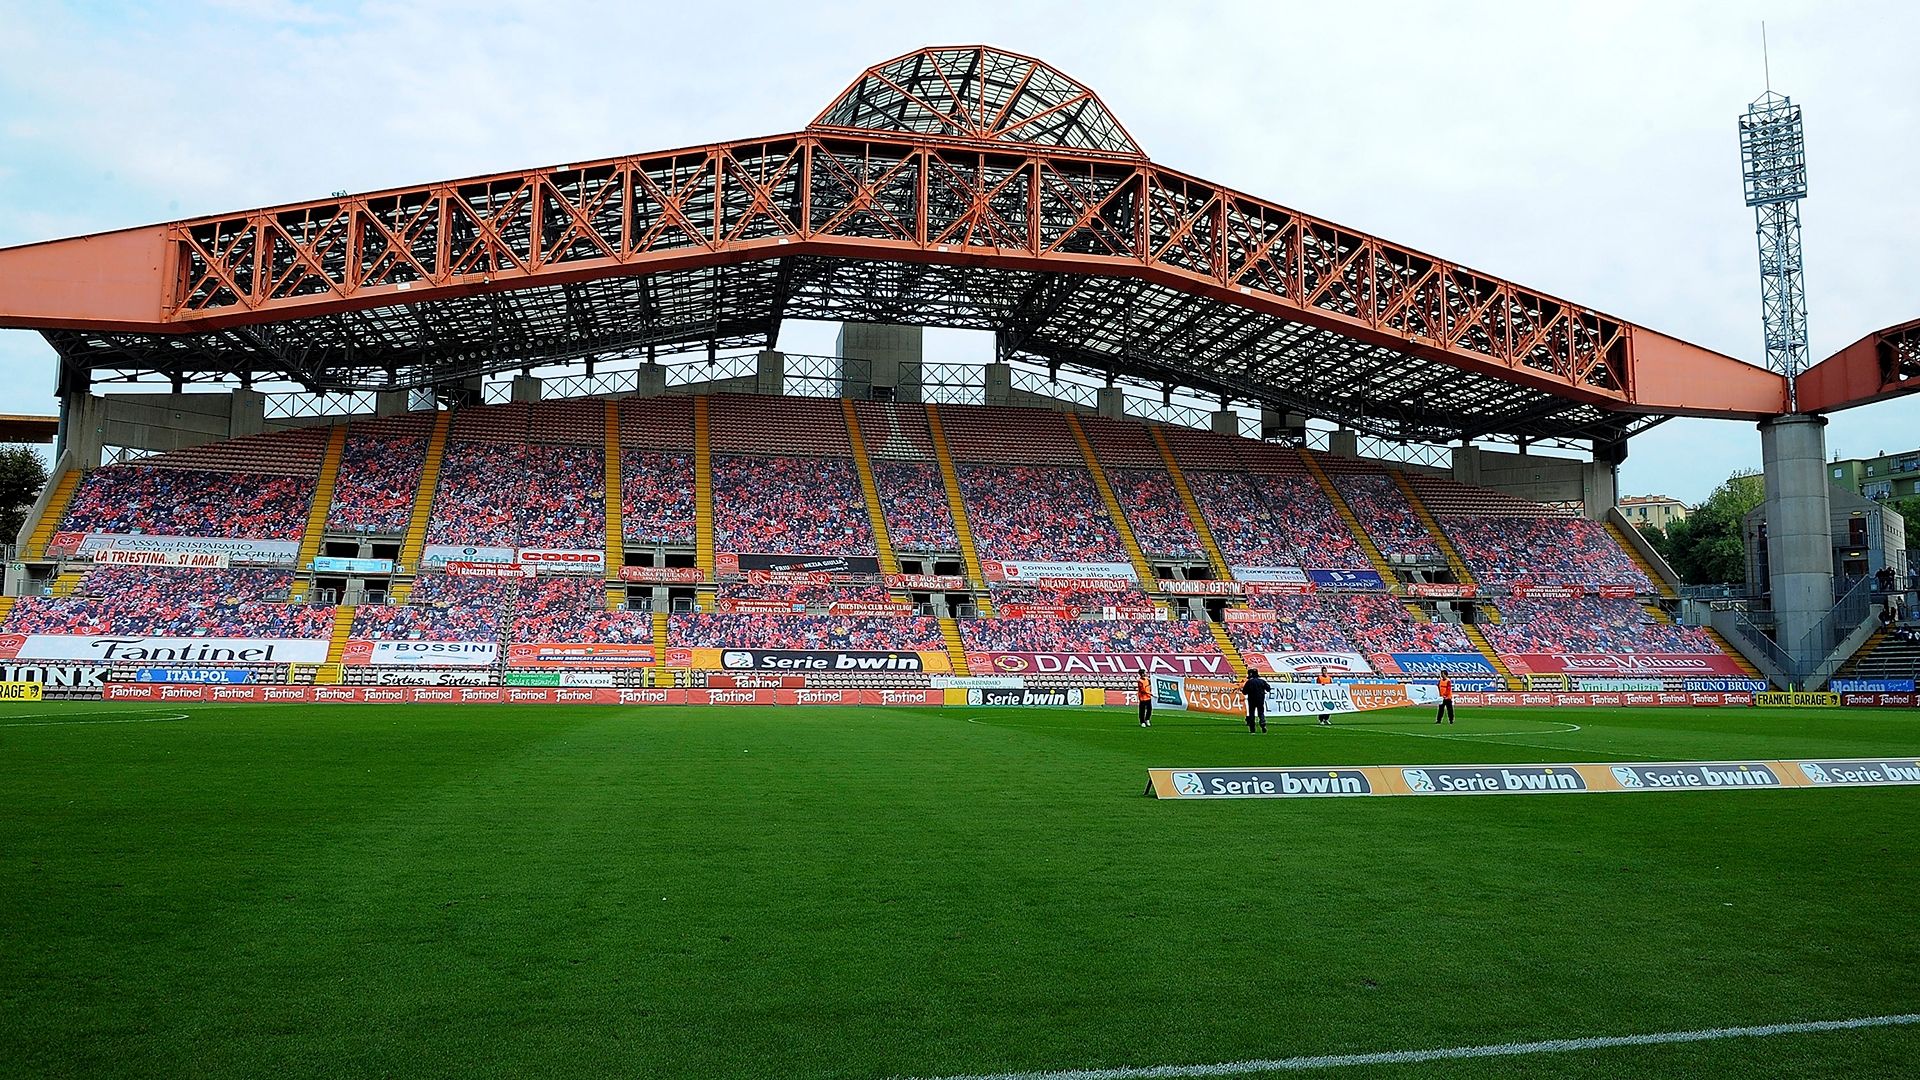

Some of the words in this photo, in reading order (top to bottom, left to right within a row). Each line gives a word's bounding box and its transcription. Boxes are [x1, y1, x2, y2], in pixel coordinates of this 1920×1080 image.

[176, 541, 253, 550] RISPARMIO
[94, 550, 108, 562] LA
[178, 554, 189, 565] SI
[191, 555, 220, 566] AMA!
[91, 638, 274, 662] Fantinel
[396, 643, 493, 653] BOSSINI
[760, 655, 828, 668] Serie
[834, 654, 919, 670] bwin
[1036, 654, 1178, 673] DAHLIA
[1175, 656, 1222, 672] TV
[1403, 662, 1489, 671] PALMANOVA
[1552, 654, 1606, 668] Testa
[1610, 654, 1707, 668] Molinaro
[166, 670, 229, 682] ITALPOL
[380, 674, 424, 686] Sixtus
[437, 674, 481, 686] Sixtus
[731, 675, 783, 688] Fantinel
[108, 685, 152, 699] Fantinel
[1186, 684, 1209, 692] MANDA
[1451, 684, 1484, 692] ERVICE
[1686, 680, 1726, 691] BRUNO
[1728, 681, 1766, 691] BRUNO
[158, 686, 202, 700] Fantinel
[206, 686, 254, 700] Fantinel
[261, 686, 304, 700] Fantinel
[312, 687, 355, 700] Fantinel
[362, 688, 403, 702] Fantinel
[412, 688, 453, 702] Fantinel
[458, 688, 499, 702] Fantinel
[507, 689, 548, 702] Fantinel
[554, 689, 593, 702] Fantinel
[616, 688, 668, 704] Fantinel
[706, 689, 756, 704] Fantinel
[794, 688, 842, 704] Fantinel
[880, 690, 926, 704] Fantinel
[986, 692, 1020, 706] Serie
[1022, 690, 1065, 705] bwin
[1301, 688, 1349, 700] L'ITALIA
[1554, 693, 1586, 705] Fantinel
[1590, 693, 1620, 705] Fantinel
[1624, 692, 1654, 704] Fantinel
[1656, 692, 1686, 704] Fantinel
[1690, 692, 1719, 704] Fantinel
[1722, 692, 1750, 704] Fantinel
[1758, 694, 1791, 705] FRANKIE
[1794, 694, 1827, 705] GARAGE
[1189, 690, 1244, 710] 45504
[1276, 700, 1302, 712] TUO
[1486, 694, 1516, 706] Fantinel
[1520, 694, 1550, 706] Fantinel
[1844, 694, 1874, 706] Fantinel
[1878, 694, 1910, 706] Fantinel
[1441, 774, 1498, 792] Serie
[1500, 768, 1578, 791] bwin
[1644, 771, 1702, 787] Serie
[1700, 765, 1772, 786] bwin
[1830, 768, 1884, 784] Serie
[1210, 776, 1275, 795] Serie
[1282, 772, 1362, 794] bwin
